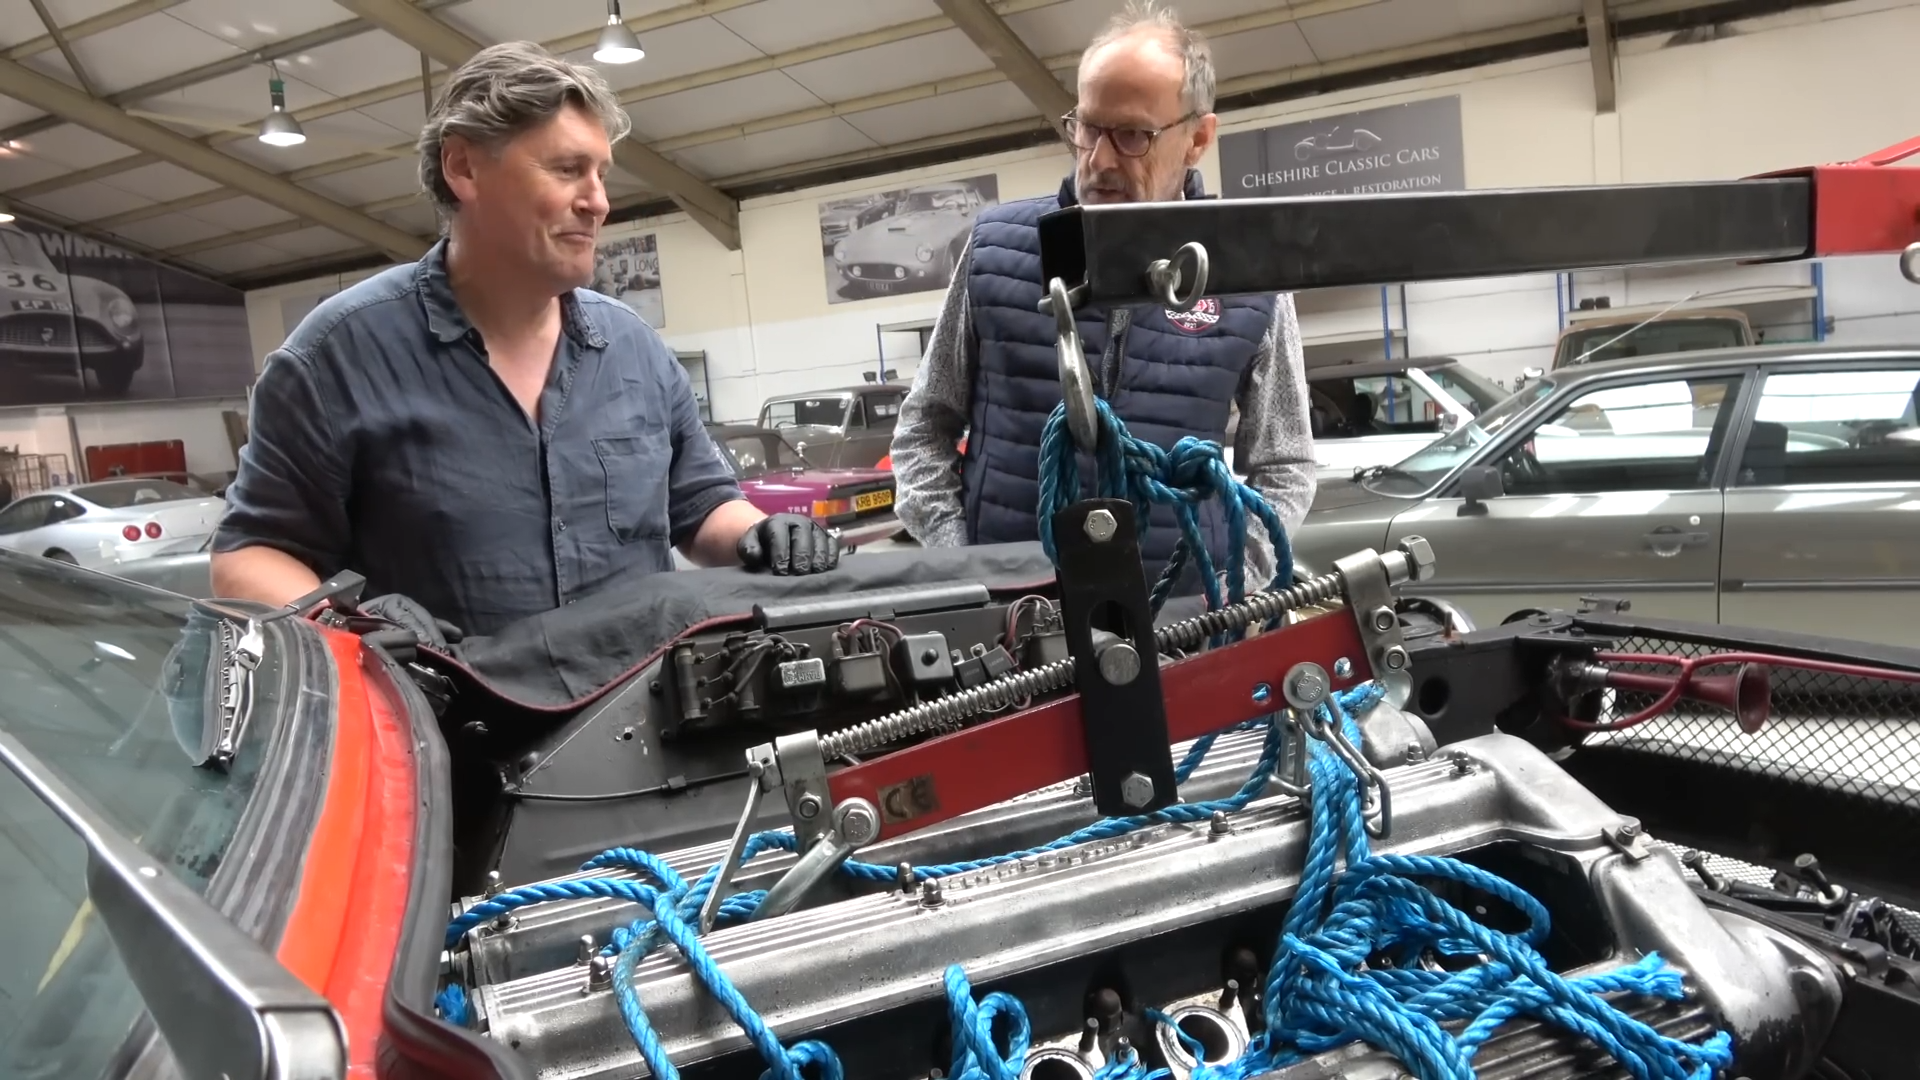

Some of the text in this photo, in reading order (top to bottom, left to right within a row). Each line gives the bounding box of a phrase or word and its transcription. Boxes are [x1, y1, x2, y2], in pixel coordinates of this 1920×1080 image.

[1241, 146, 1440, 189] CHESHIRE CLASSIC CARS
[1352, 174, 1442, 195] RESTORATION
[855, 495, 871, 509] KRB
